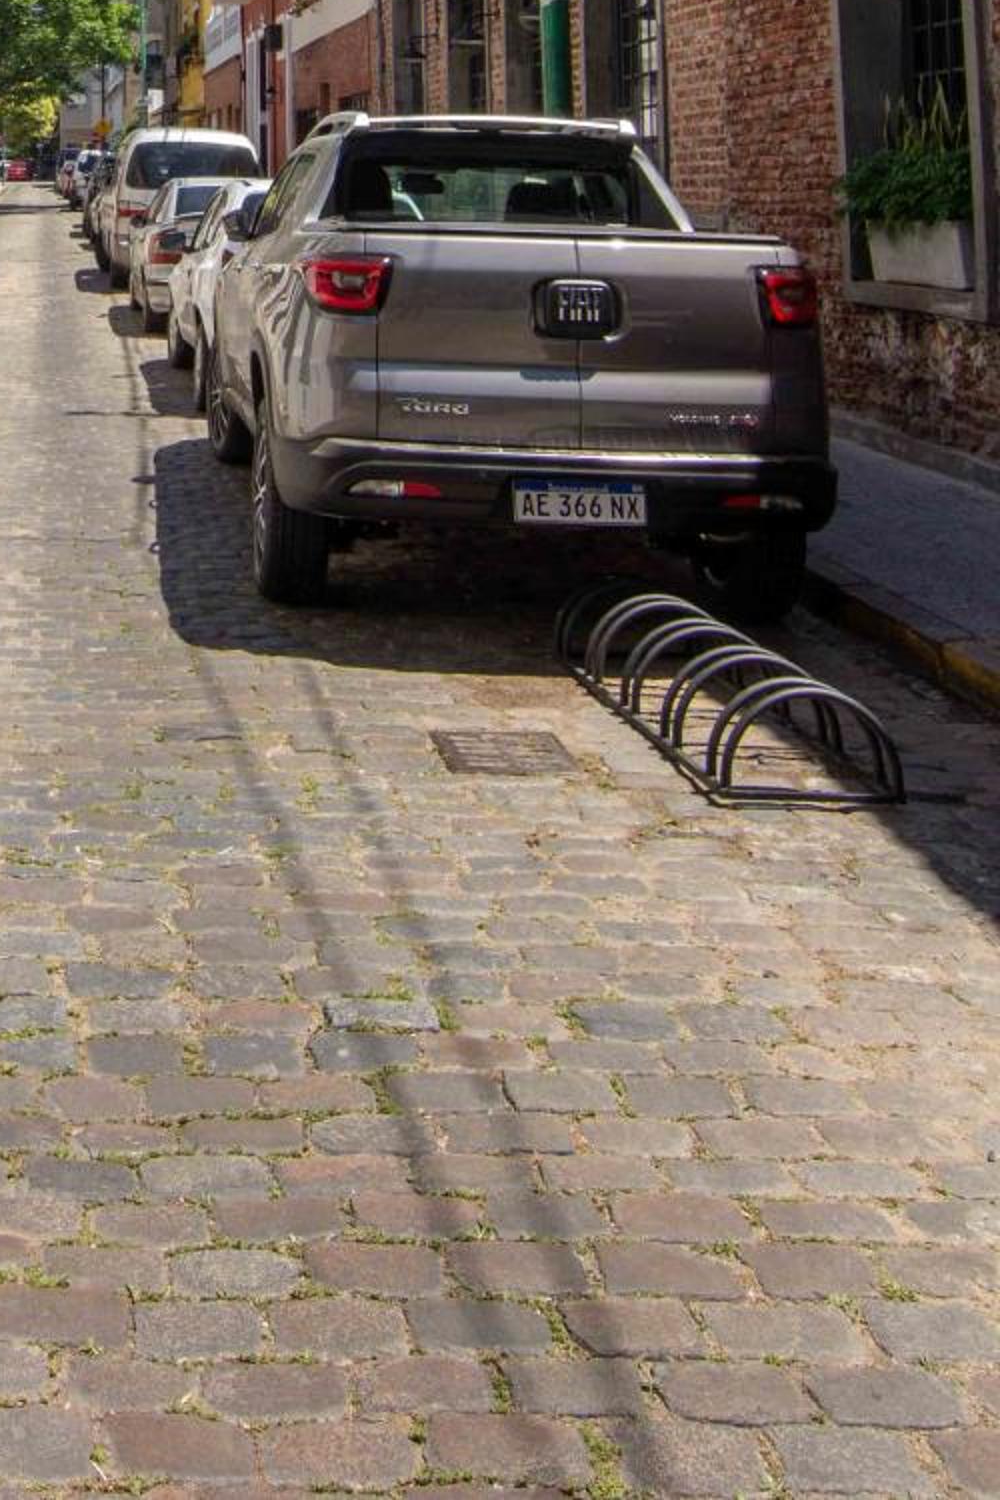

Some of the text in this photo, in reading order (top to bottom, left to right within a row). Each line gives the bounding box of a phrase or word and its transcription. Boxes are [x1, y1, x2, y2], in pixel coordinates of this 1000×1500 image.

[522, 493, 640, 519] AE 366 NX
